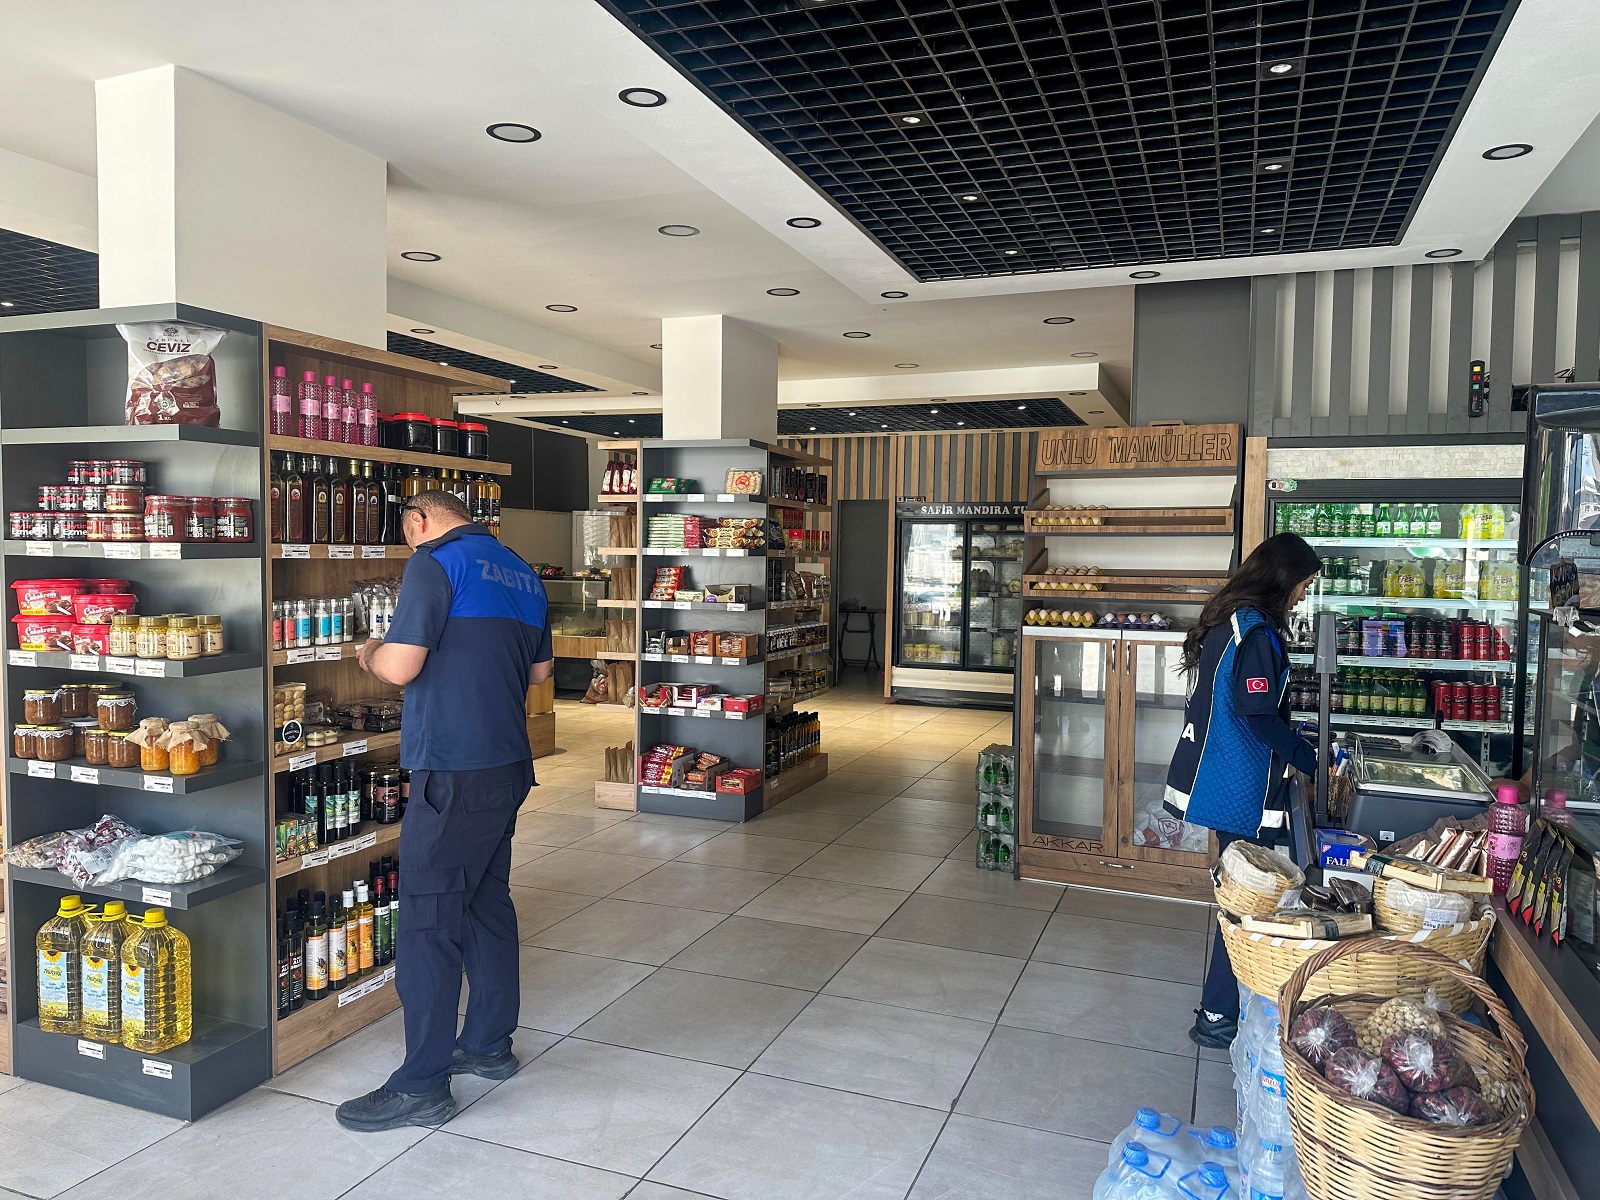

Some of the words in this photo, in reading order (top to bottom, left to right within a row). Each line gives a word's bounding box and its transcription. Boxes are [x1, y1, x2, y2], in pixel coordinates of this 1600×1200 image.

[1041, 437, 1098, 466] UNLU
[1109, 428, 1232, 464] MAMÜLLER
[920, 504, 954, 515] SAFİR
[956, 505, 1011, 515] MANDIRA
[476, 559, 543, 598] ZABITA
[1032, 835, 1104, 853] AKKAR
